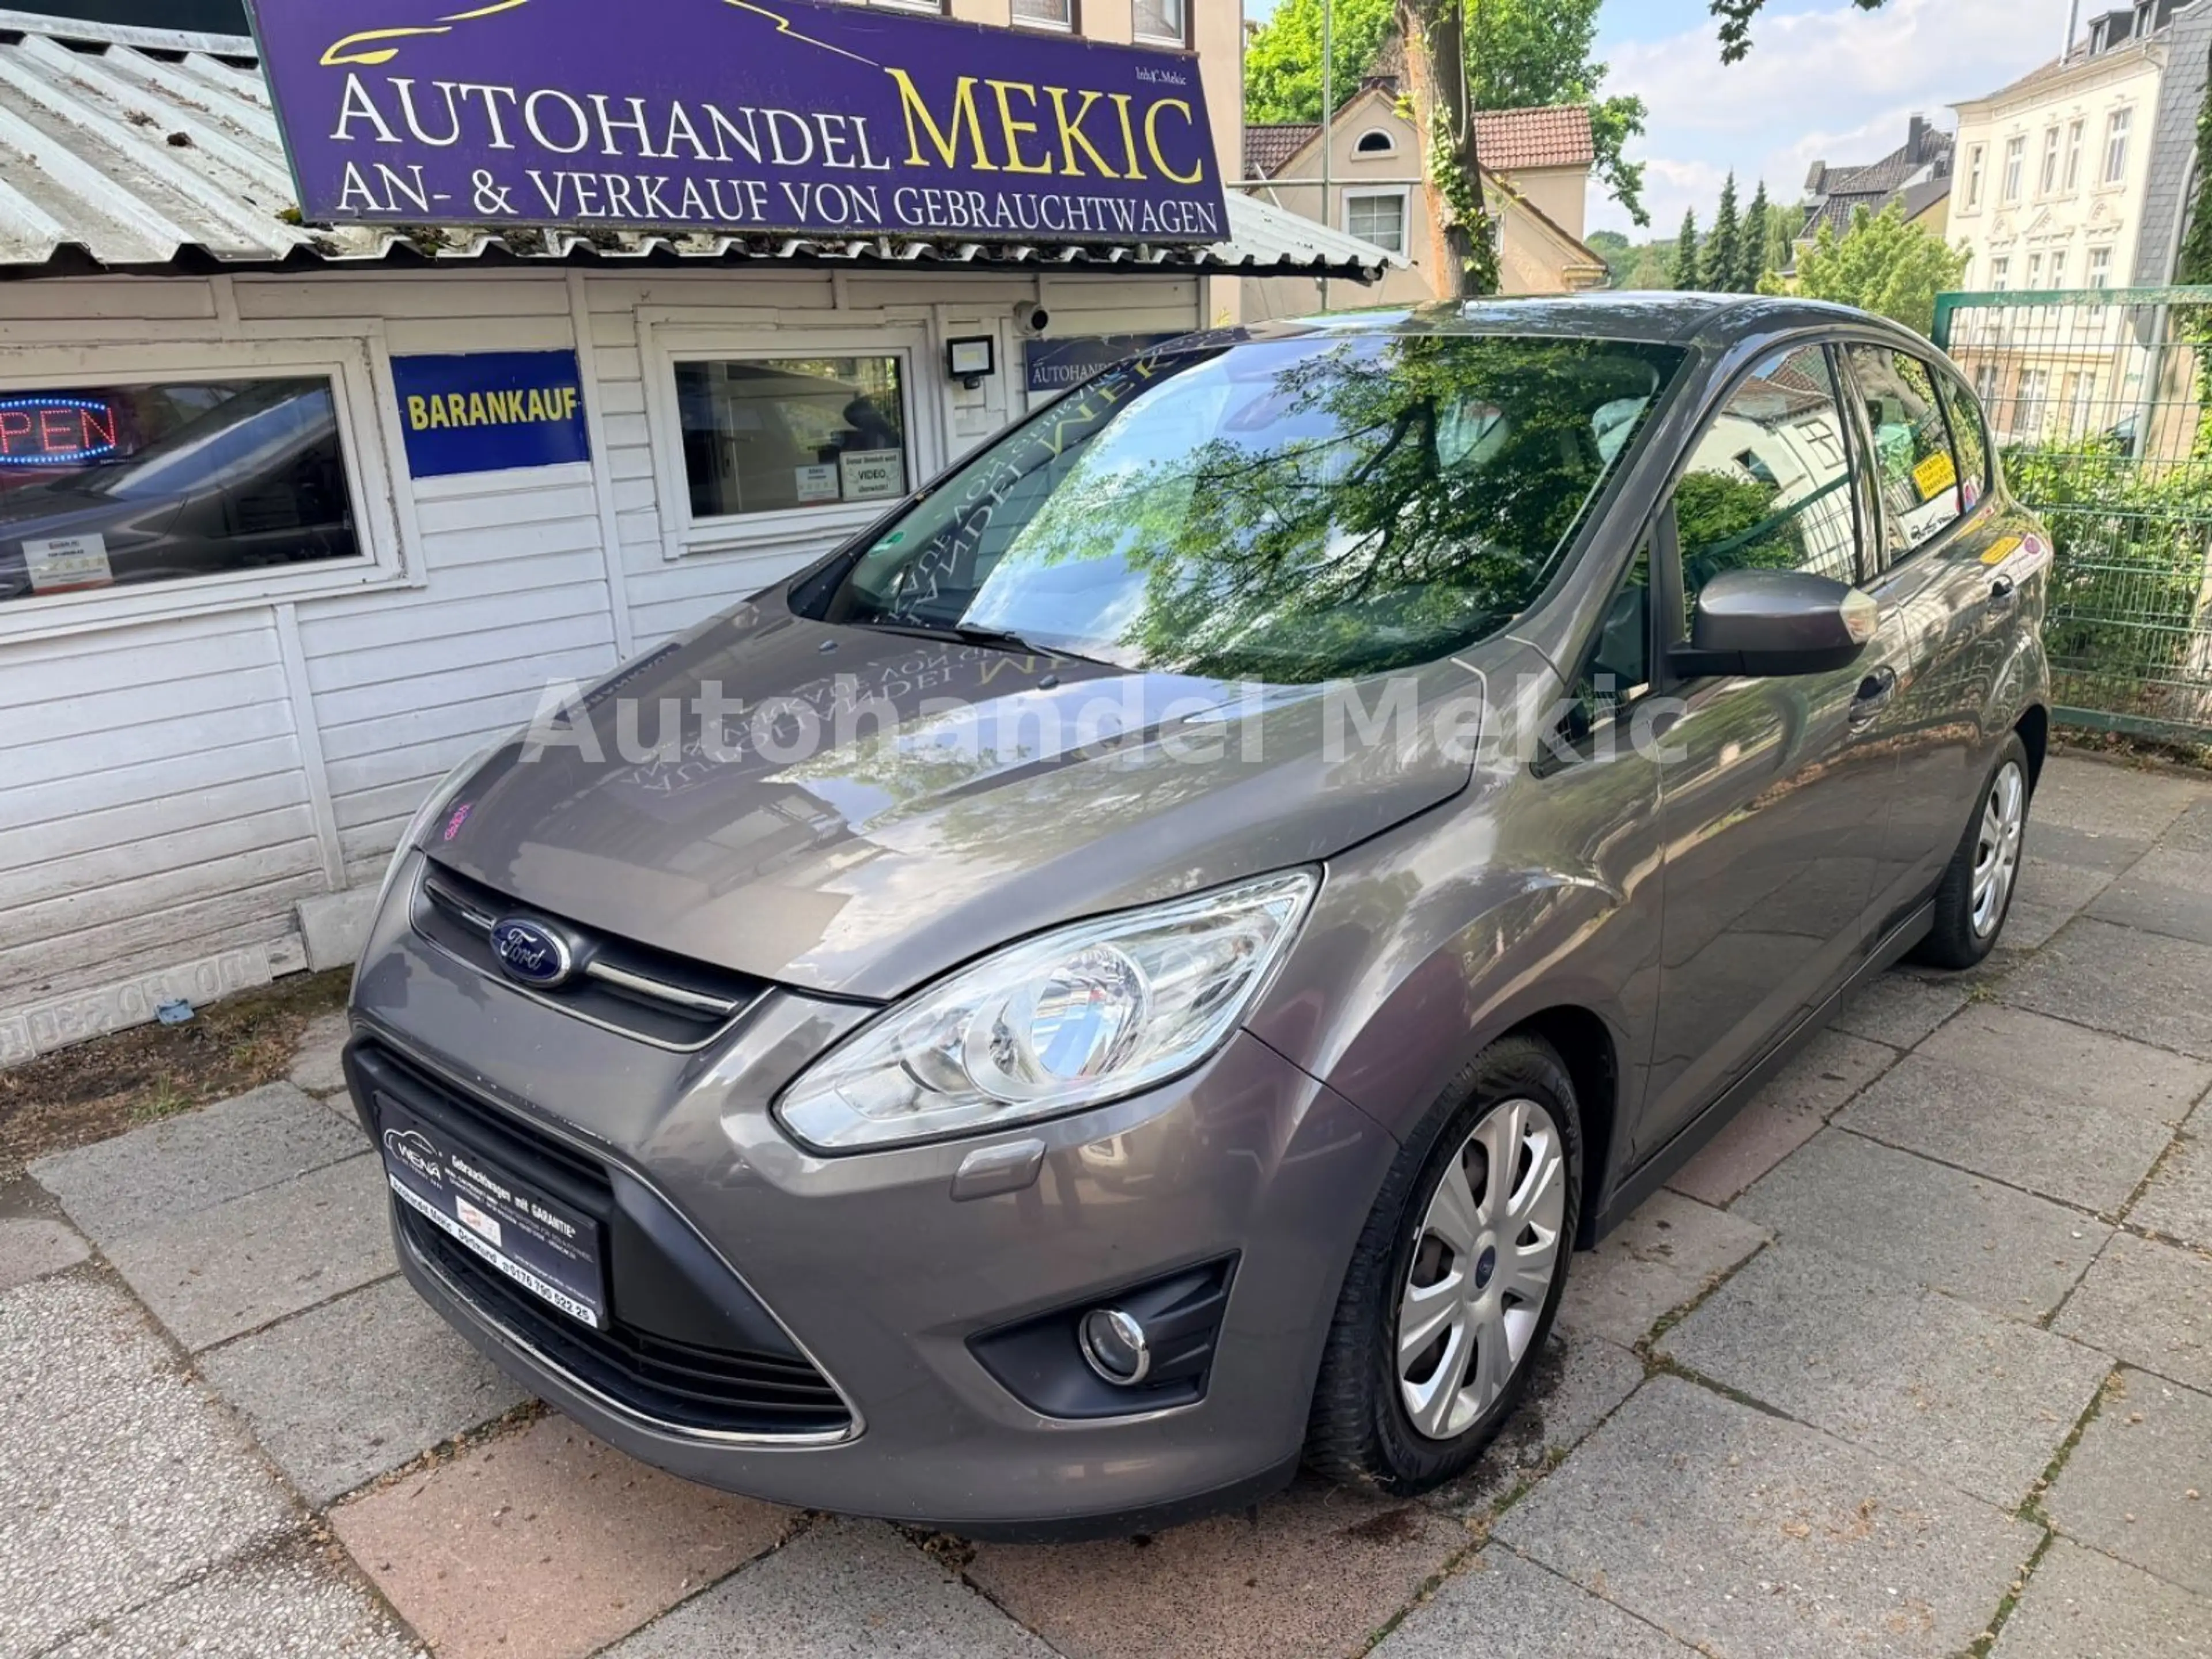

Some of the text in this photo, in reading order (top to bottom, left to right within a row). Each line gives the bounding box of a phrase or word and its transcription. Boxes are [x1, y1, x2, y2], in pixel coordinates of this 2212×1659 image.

[329, 66, 1203, 184] AUTOHANDEL MEKIC
[336, 161, 1219, 233] AN- & VERKAUF VON GEBRAUCHTWAGEN
[407, 387, 578, 431] BARANKAUF
[858, 468, 886, 480] VIDEO
[500, 927, 546, 970] Ford
